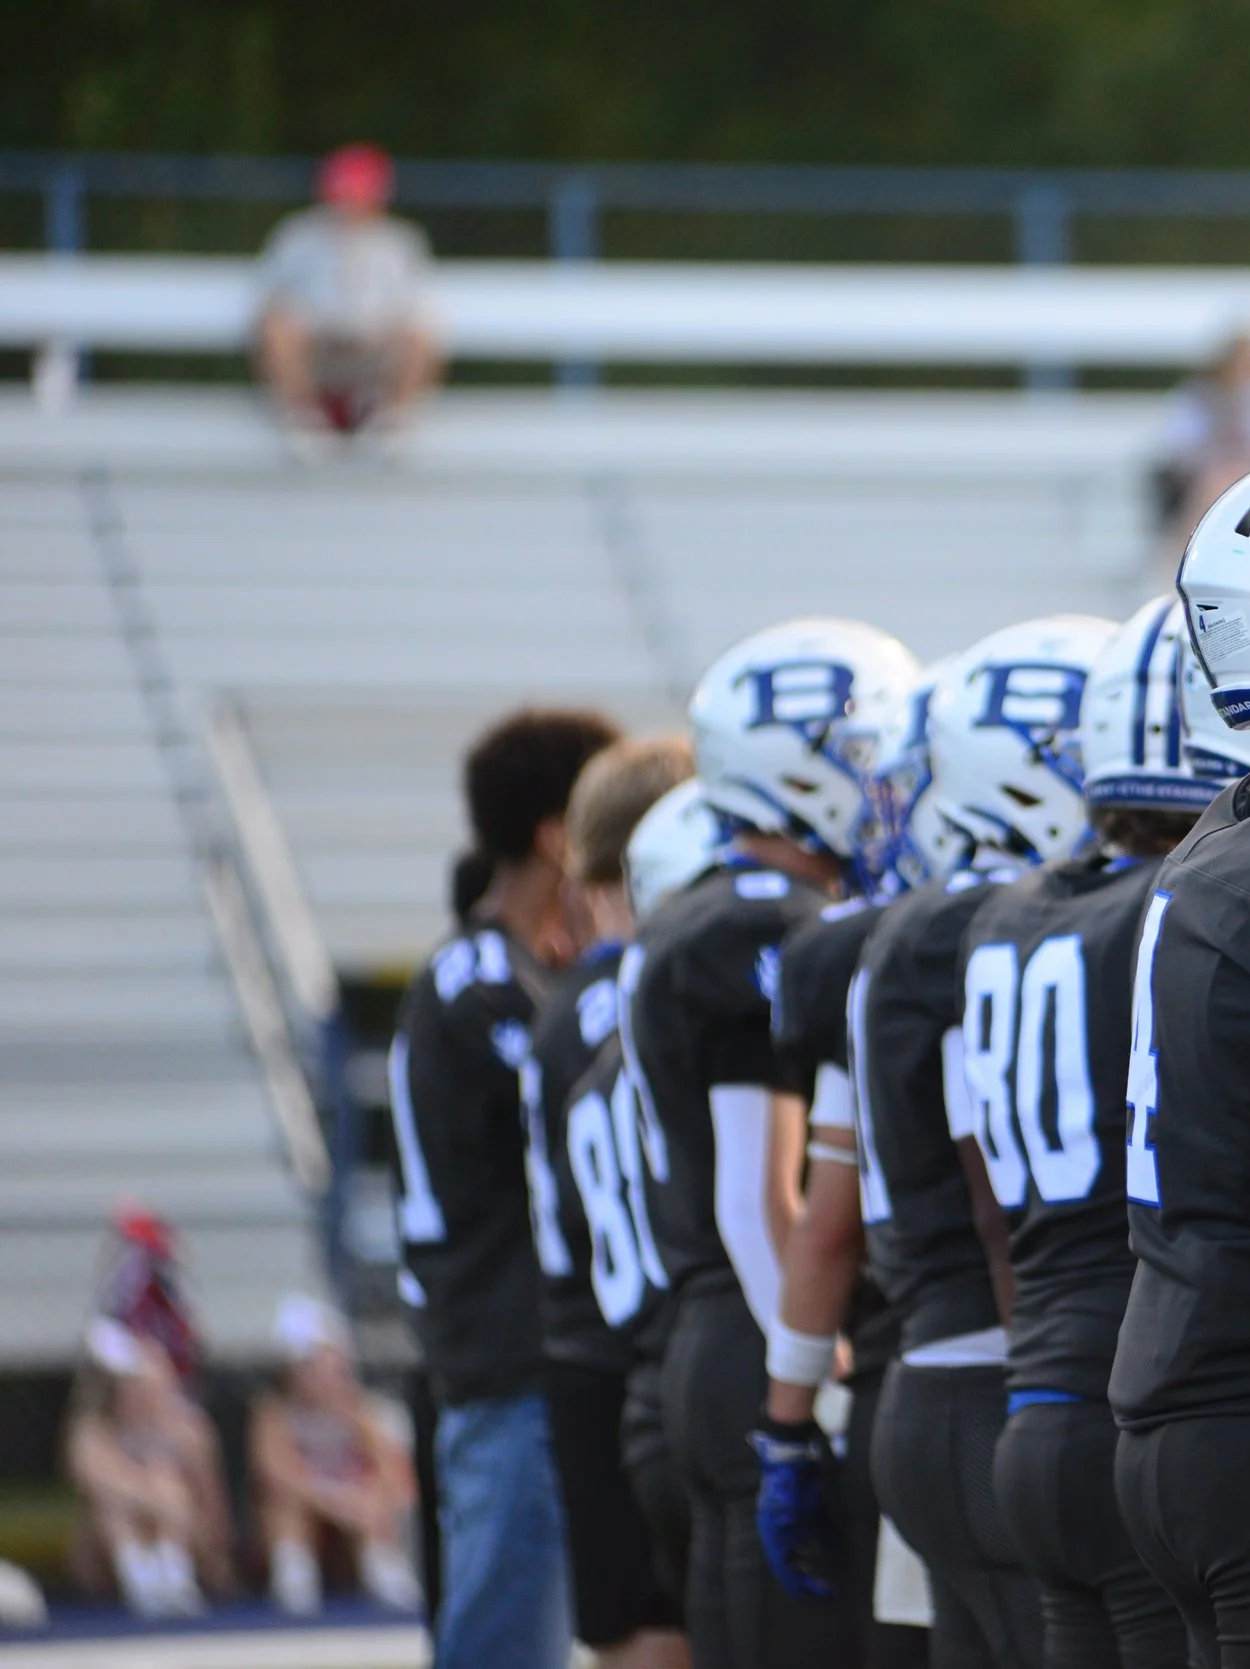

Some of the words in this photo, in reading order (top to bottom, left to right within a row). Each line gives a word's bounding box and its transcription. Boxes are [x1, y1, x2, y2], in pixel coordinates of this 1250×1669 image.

[742, 660, 854, 729] B
[970, 662, 1088, 729] B
[963, 932, 1102, 1211] 80
